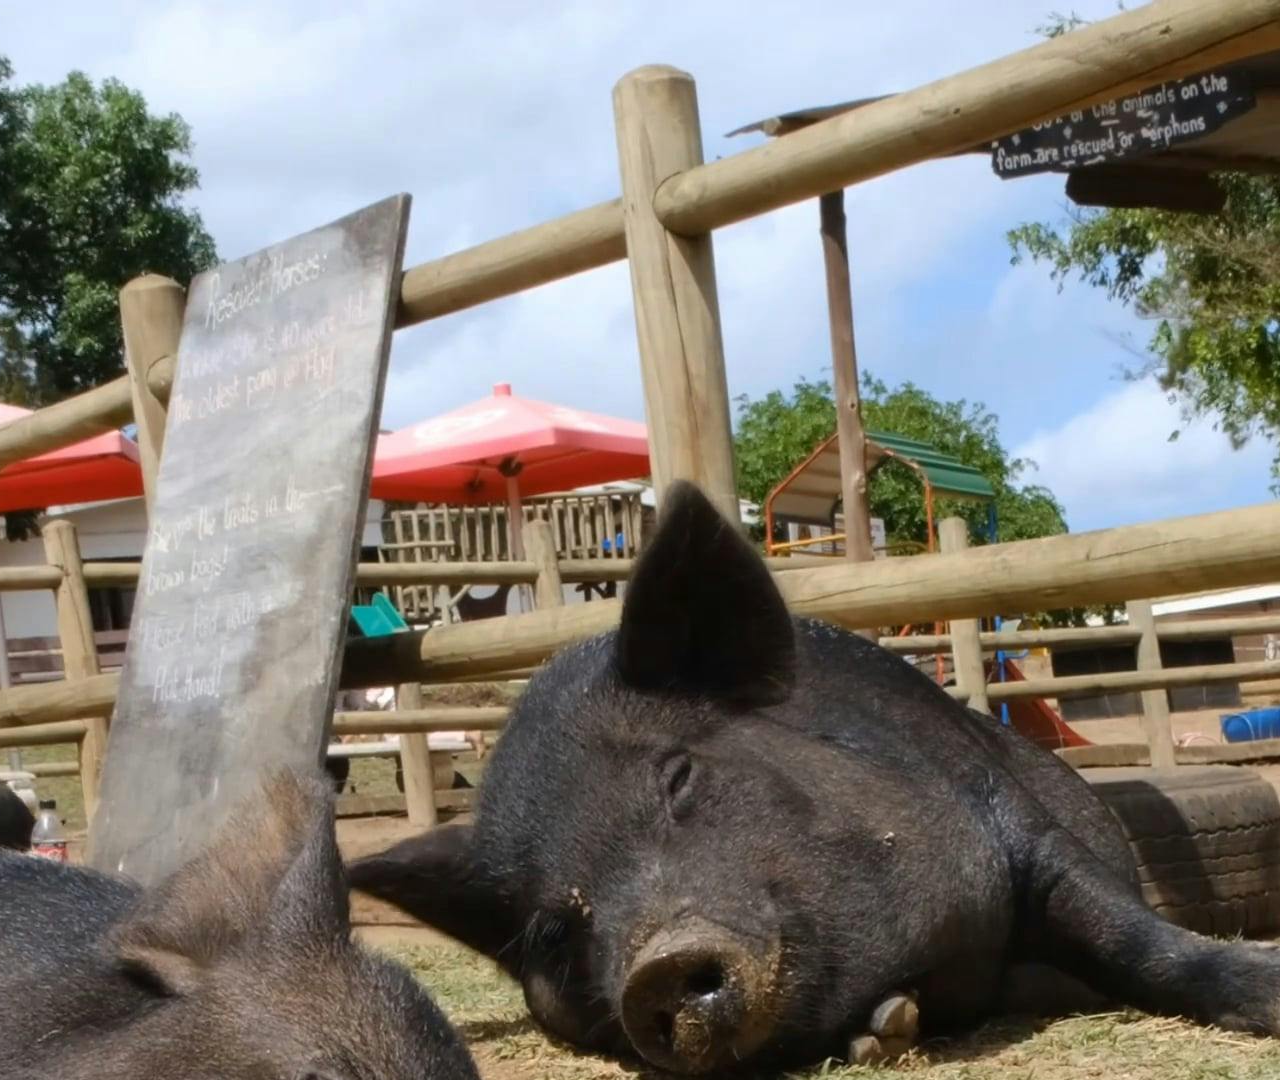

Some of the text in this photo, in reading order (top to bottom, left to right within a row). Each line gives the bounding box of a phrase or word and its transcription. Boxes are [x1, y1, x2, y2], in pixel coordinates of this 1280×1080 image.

[1123, 84, 1176, 111] animals
[1181, 81, 1199, 100] on
[1200, 73, 1229, 95] the
[1063, 130, 1115, 158] rescued
[1120, 132, 1135, 148] or
